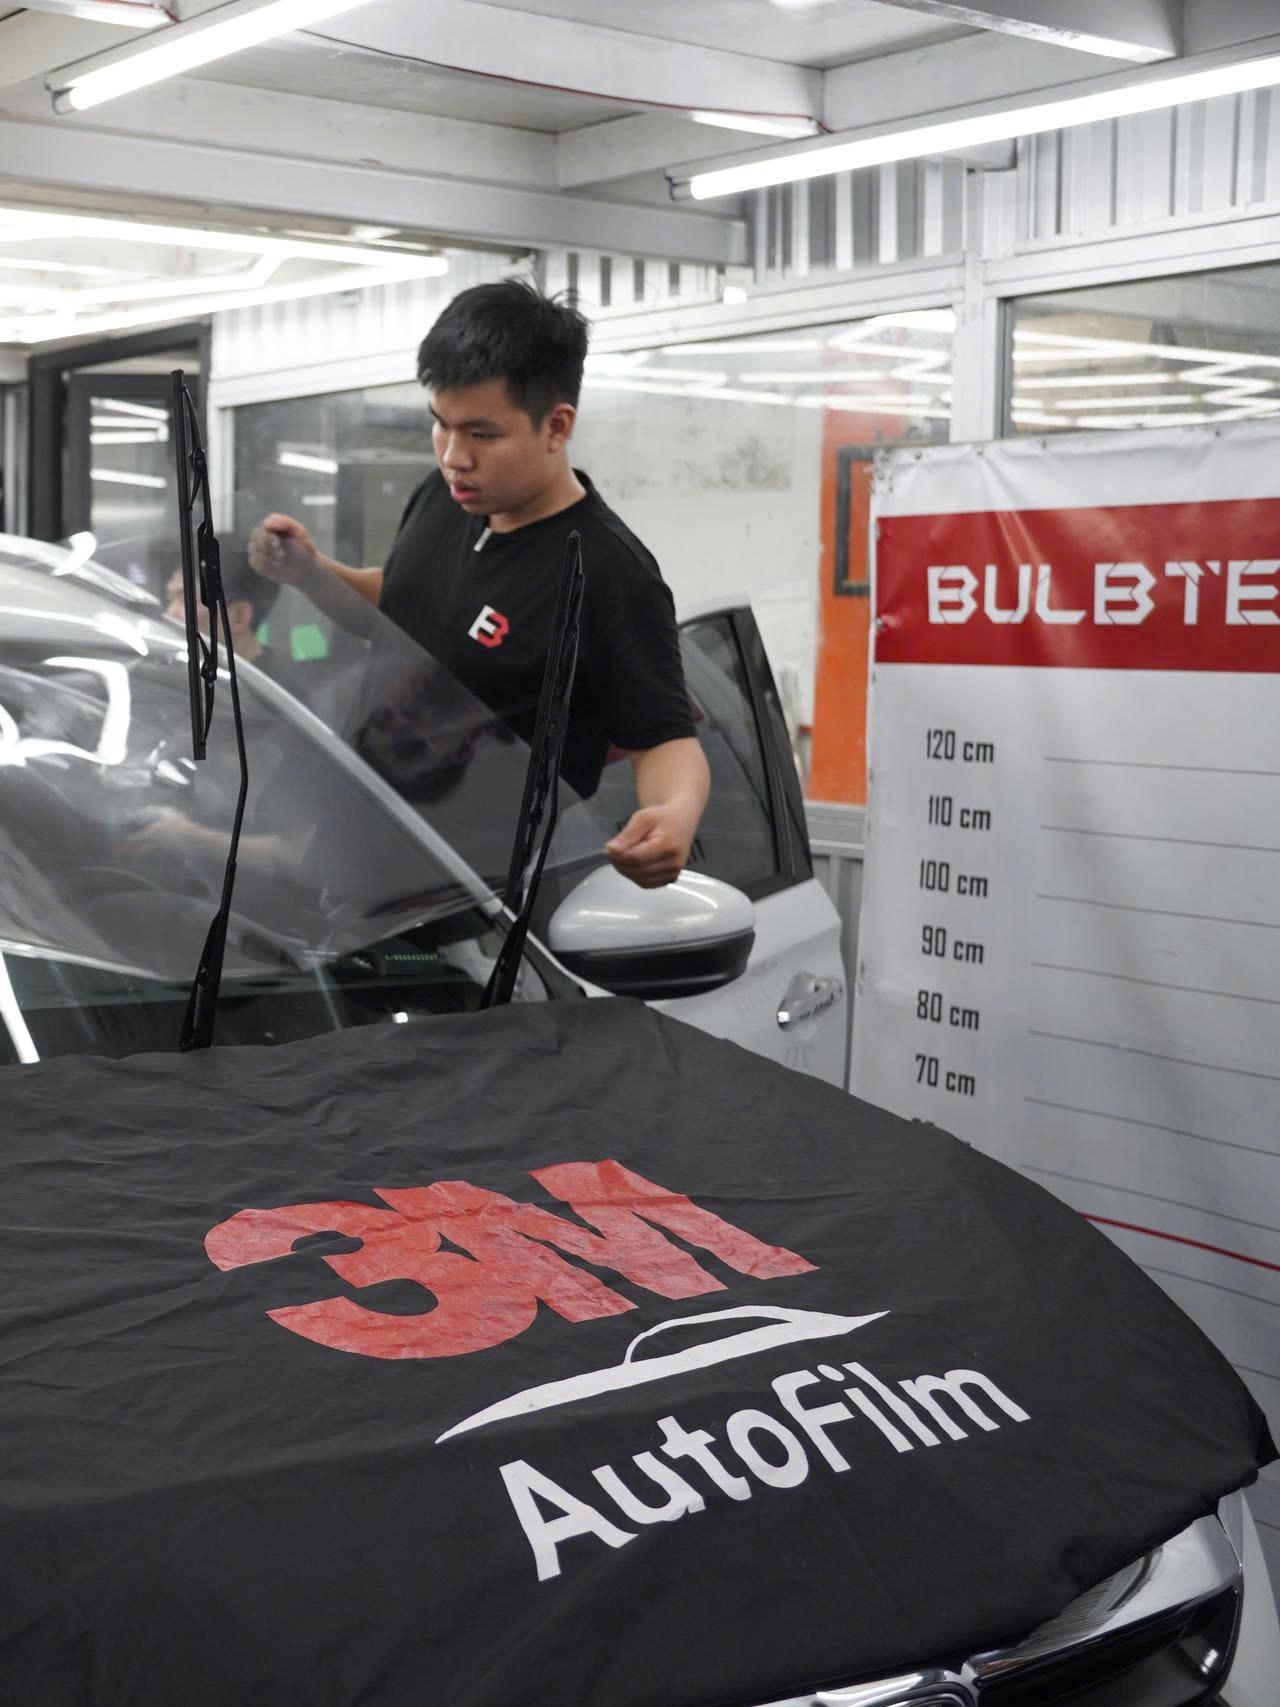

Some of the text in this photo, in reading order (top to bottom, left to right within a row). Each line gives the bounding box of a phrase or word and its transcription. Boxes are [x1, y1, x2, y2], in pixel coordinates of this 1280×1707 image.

[927, 560, 1280, 625] BULBTE
[926, 729, 994, 763] 120 cm
[928, 795, 991, 830] 110 cm
[920, 860, 988, 898] 100 cm
[921, 925, 984, 964] 90 cm
[917, 990, 980, 1030] 80 cm
[915, 1054, 975, 1096] 70 cm
[204, 1158, 819, 1360] 3M
[499, 1360, 1031, 1582] AutoFilm
